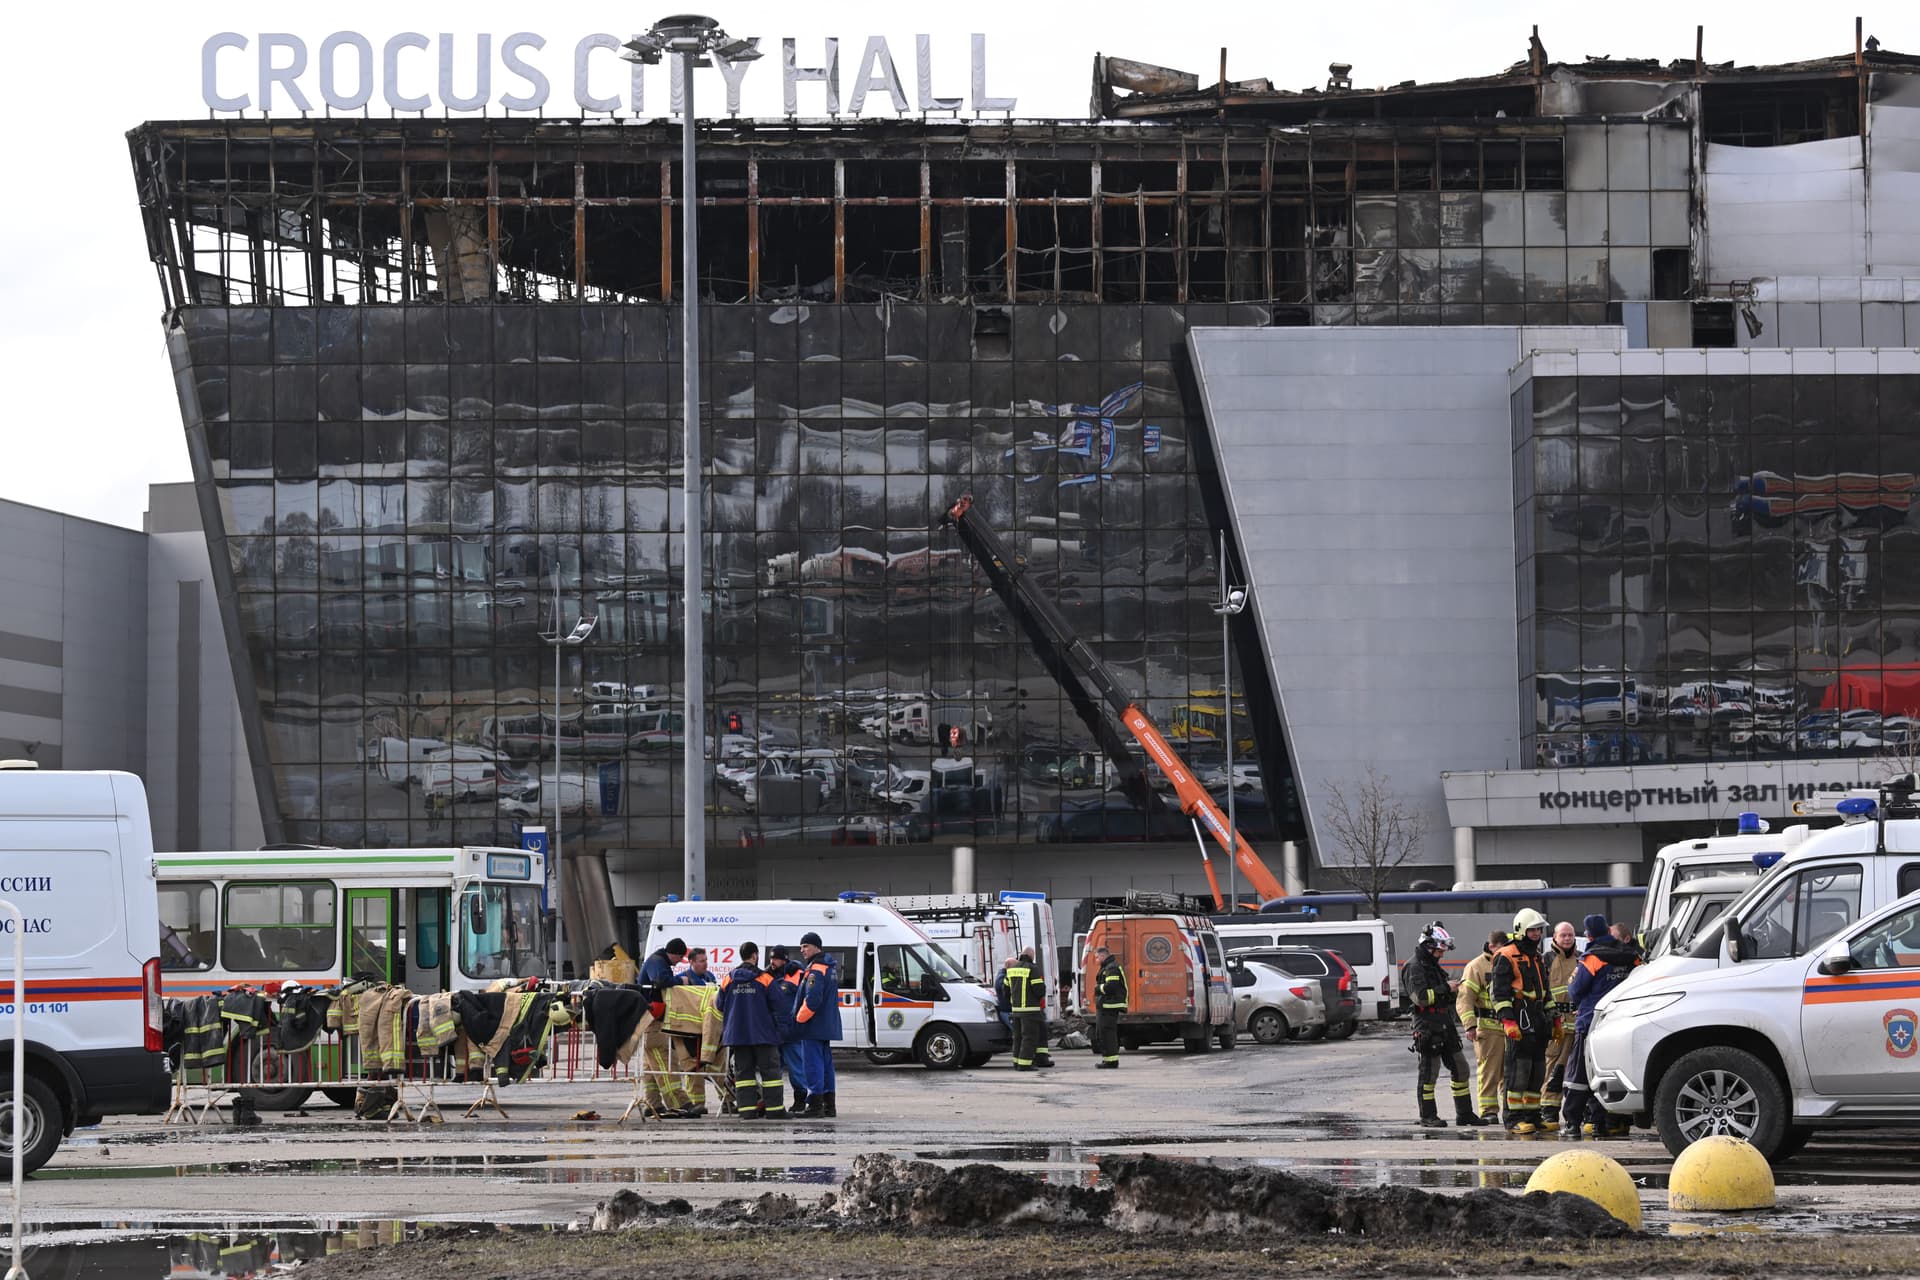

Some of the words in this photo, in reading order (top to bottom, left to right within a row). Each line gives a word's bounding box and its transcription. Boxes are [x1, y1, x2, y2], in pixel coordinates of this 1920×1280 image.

[200, 31, 551, 112] CROCUS
[783, 32, 1018, 113] HALL
[1539, 779, 1718, 812] концертный
[1727, 782, 1777, 803] зал
[703, 947, 735, 964] 12
[48, 1002, 69, 1013] 101
